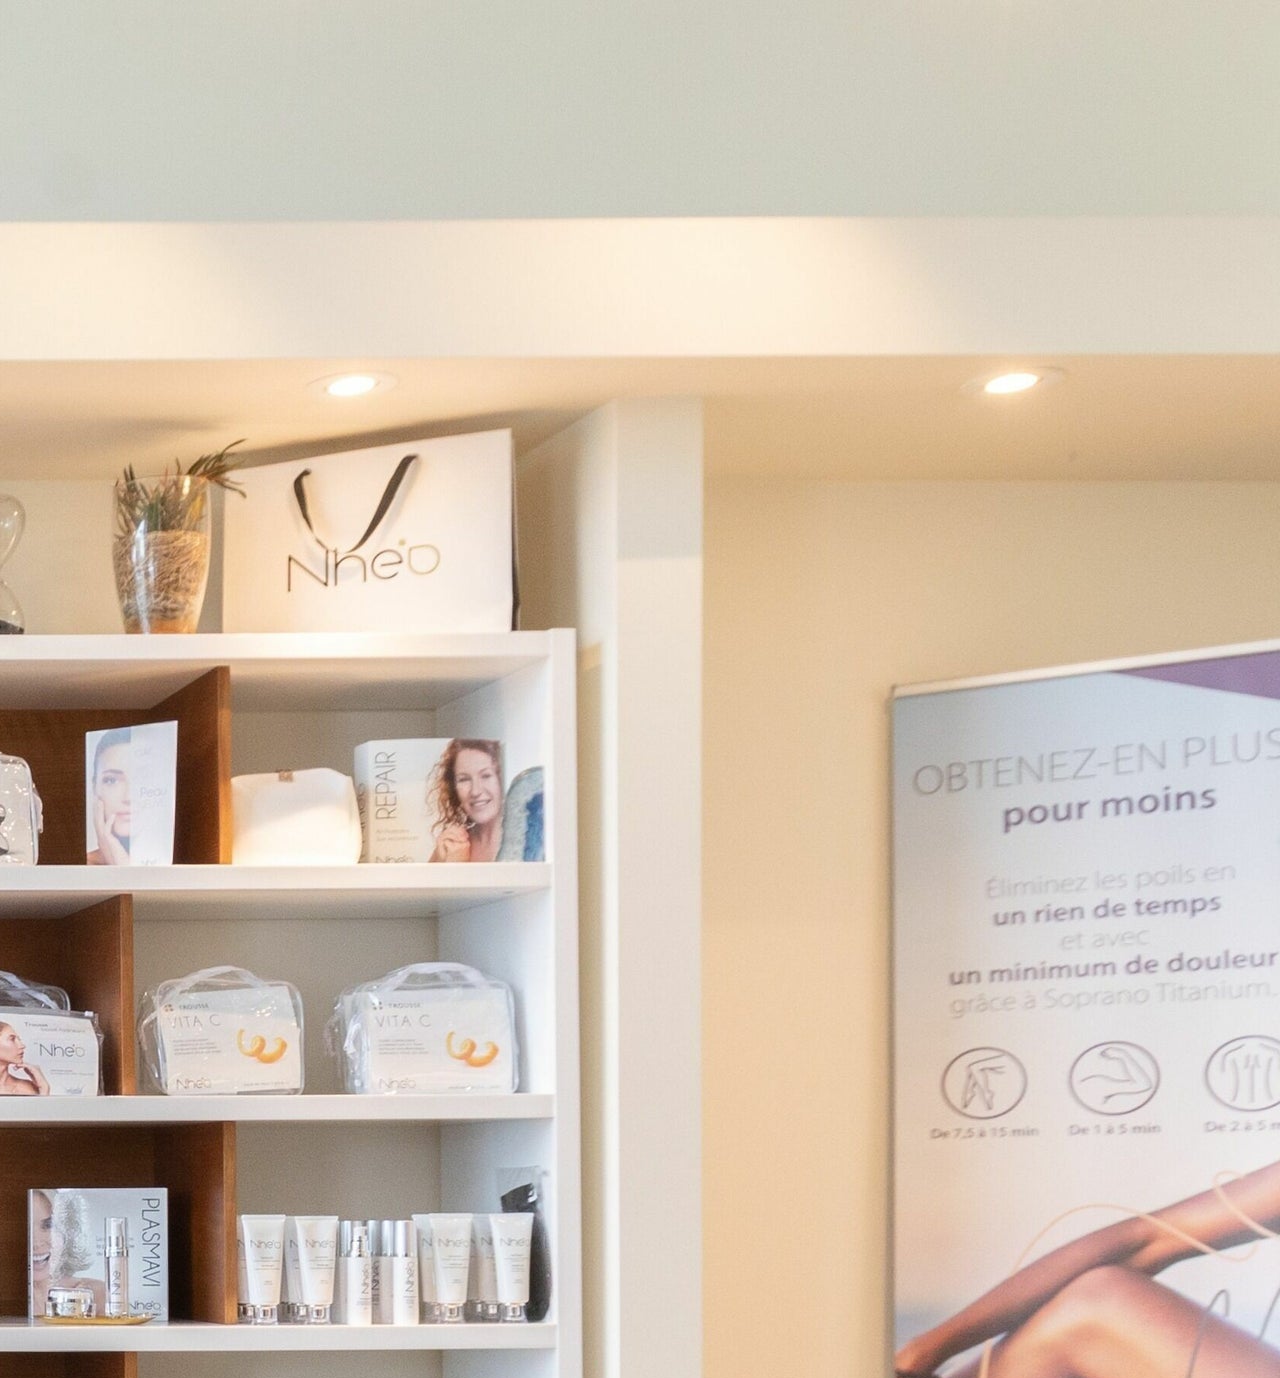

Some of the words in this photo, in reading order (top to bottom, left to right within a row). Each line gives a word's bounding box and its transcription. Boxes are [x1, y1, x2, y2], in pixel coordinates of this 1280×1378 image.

[375, 751, 397, 820] REPAIR
[912, 740, 1167, 796] OBTENEZ-EN
[1002, 798, 1090, 834] pour
[1100, 785, 1217, 820] moins
[985, 874, 1086, 899] Éliminez
[1095, 872, 1127, 891] les
[1135, 864, 1194, 893] poils
[1202, 863, 1236, 881] en
[992, 910, 1026, 927] un
[1034, 902, 1084, 922] rien
[1094, 899, 1126, 920] de
[1134, 894, 1221, 920] temps
[1060, 931, 1084, 950] et
[1091, 927, 1150, 949] avec
[948, 970, 981, 986] un
[988, 960, 1117, 984] minimum
[1125, 954, 1159, 976] de
[1167, 949, 1277, 972] douleur
[1043, 984, 1149, 1012] Soprano
[170, 1014, 203, 1028] VITA
[208, 1014, 221, 1027] C
[375, 1014, 414, 1028] VITA
[419, 1014, 432, 1027] C
[142, 1197, 160, 1288] PLASMAVI
